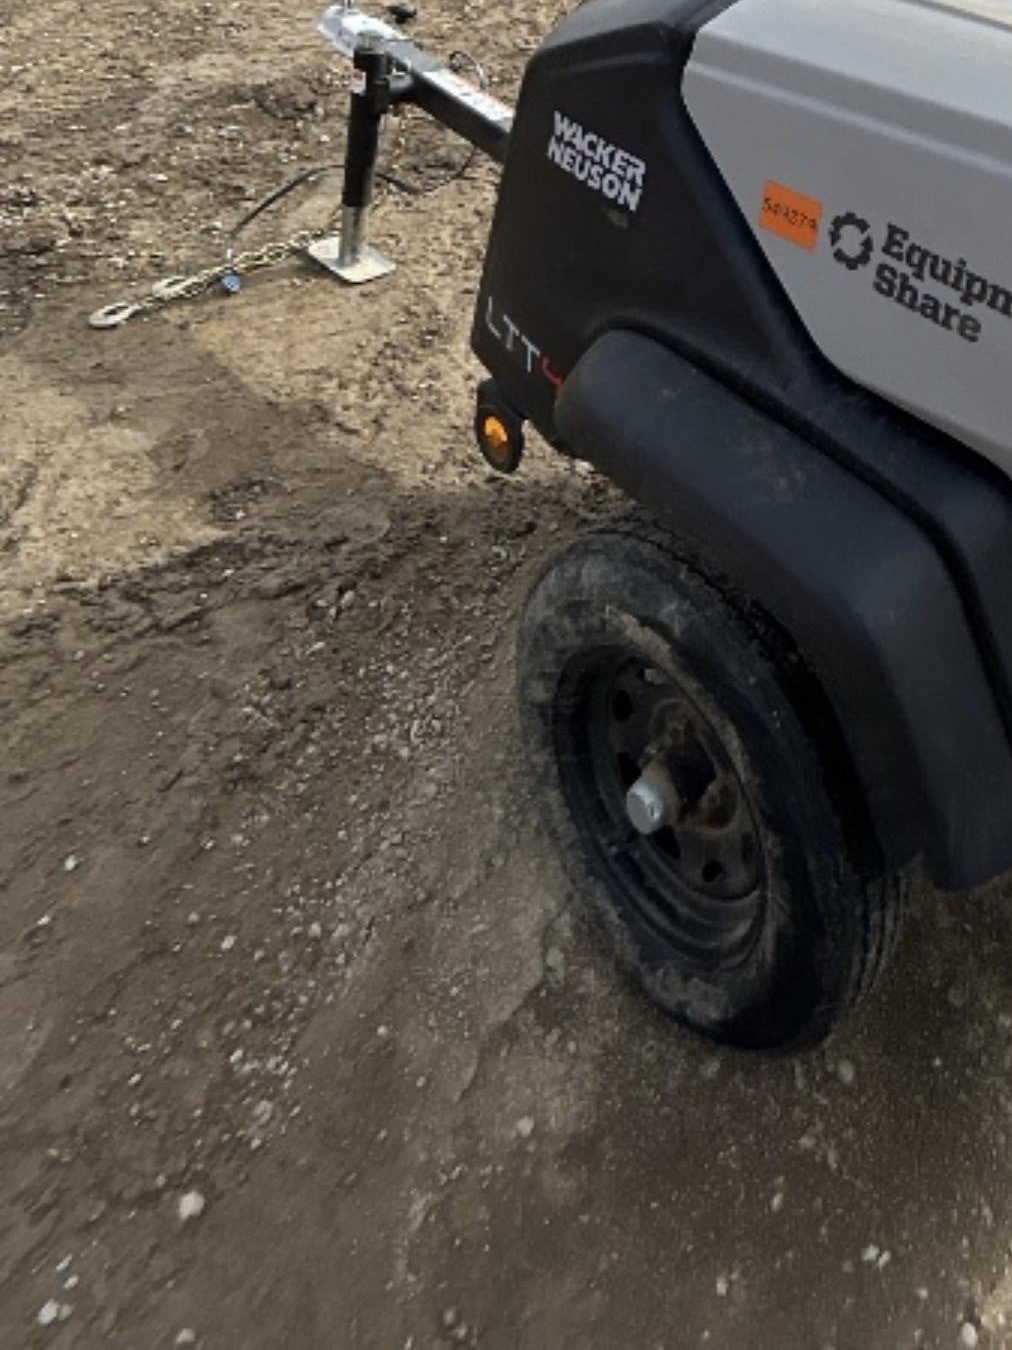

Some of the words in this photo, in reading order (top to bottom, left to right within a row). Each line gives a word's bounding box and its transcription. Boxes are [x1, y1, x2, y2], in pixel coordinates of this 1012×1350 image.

[547, 135, 642, 212] NEUSON
[553, 110, 646, 187] WACKER
[873, 262, 982, 343] Share
